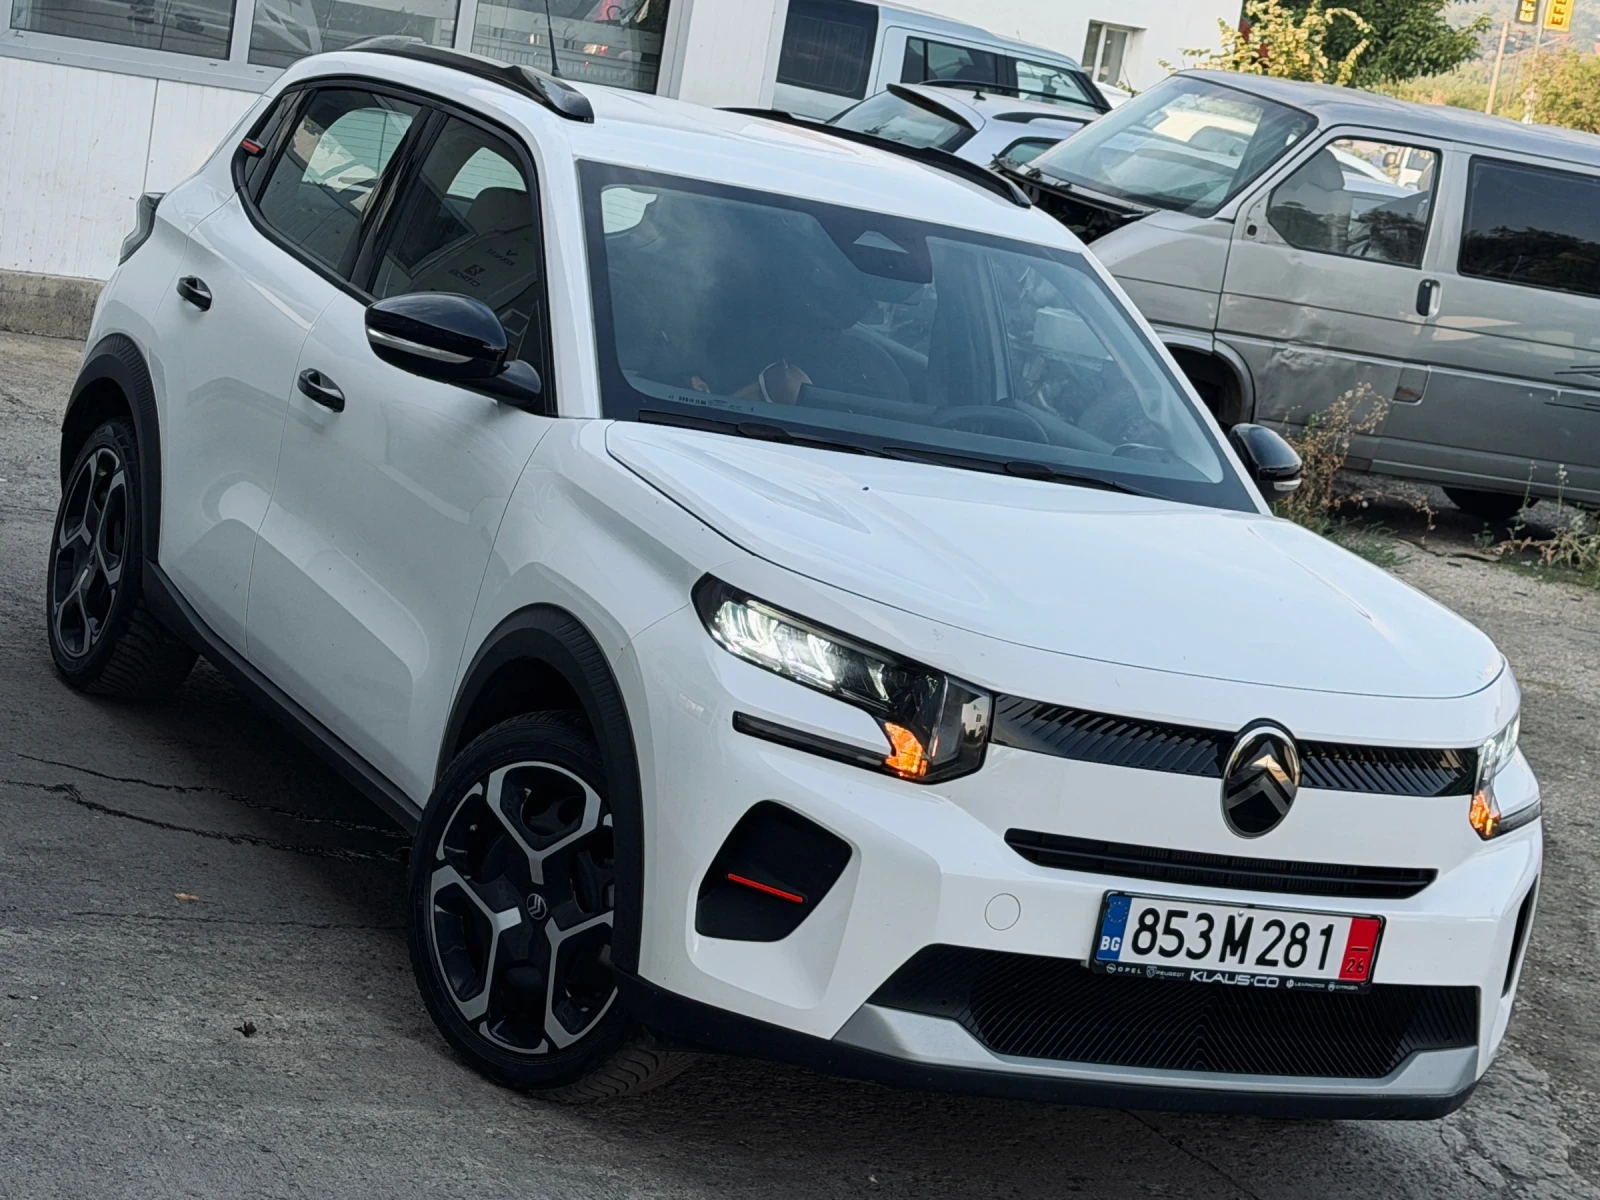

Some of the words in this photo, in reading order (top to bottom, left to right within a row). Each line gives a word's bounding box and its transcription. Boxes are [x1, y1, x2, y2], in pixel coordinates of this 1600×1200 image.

[1100, 935, 1121, 952] BG
[1345, 957, 1365, 974] 26
[1117, 966, 1142, 975] OPEL
[1155, 969, 1186, 979] PEUGEOT
